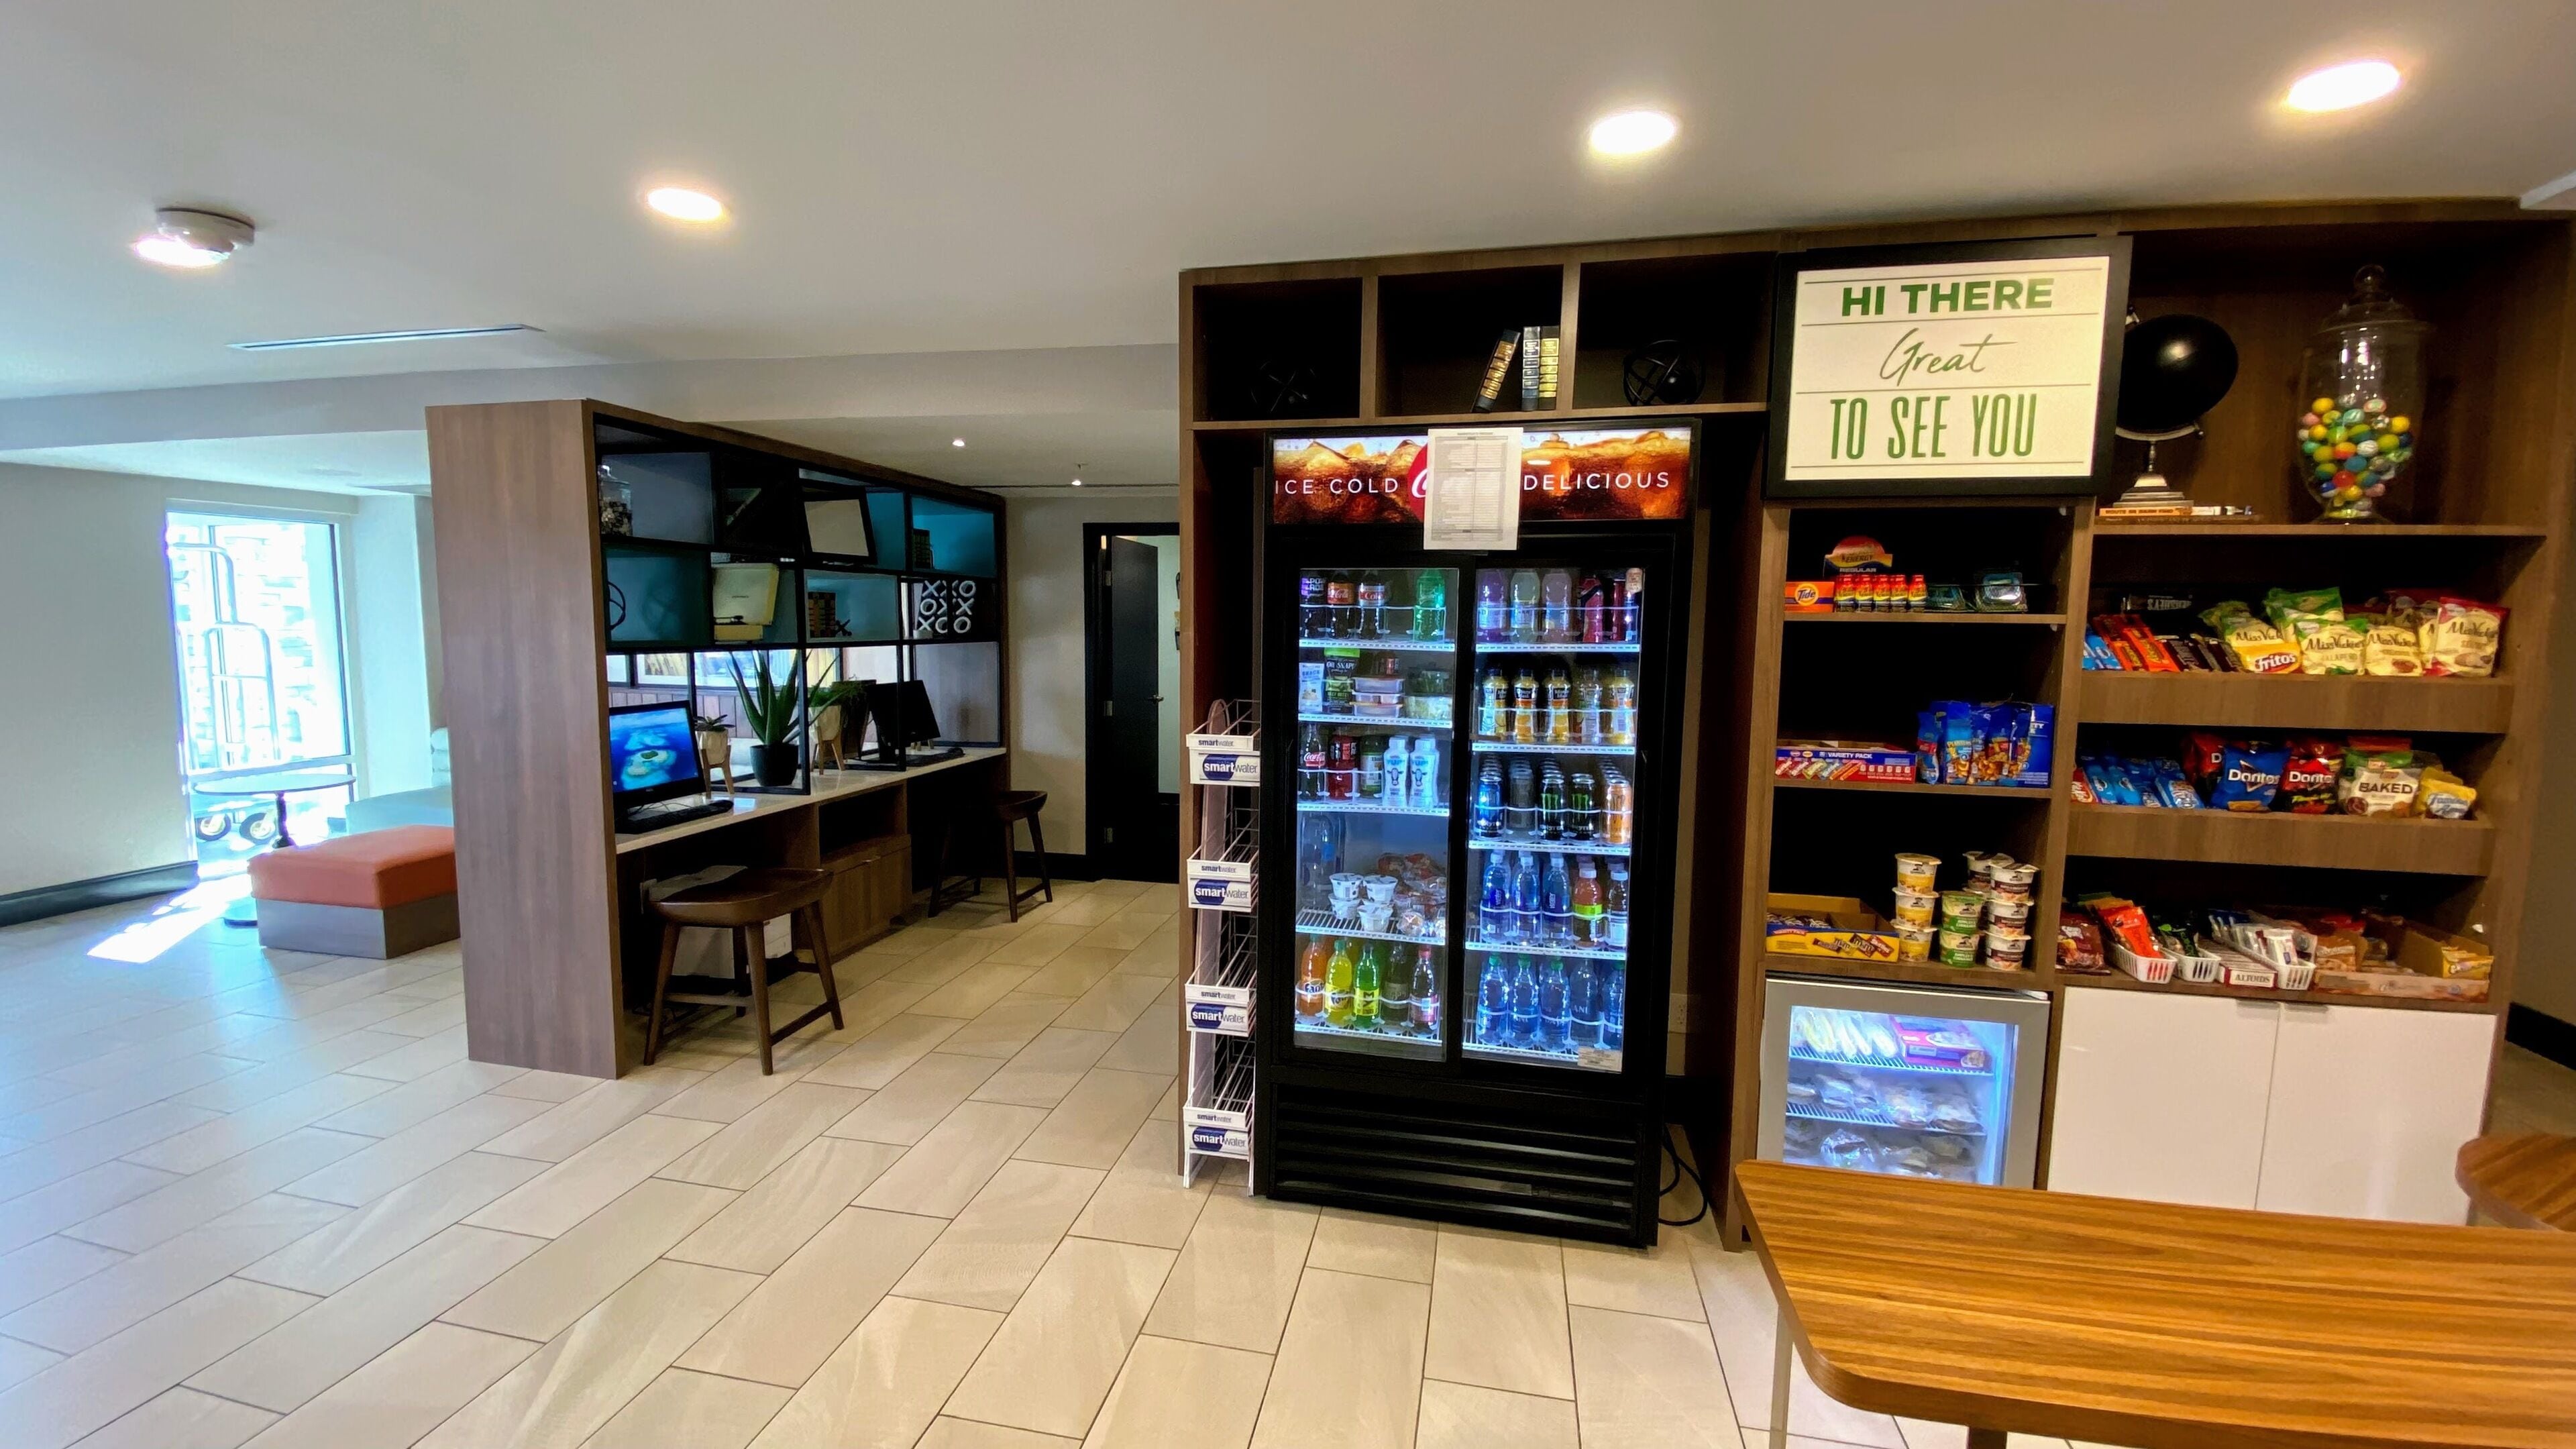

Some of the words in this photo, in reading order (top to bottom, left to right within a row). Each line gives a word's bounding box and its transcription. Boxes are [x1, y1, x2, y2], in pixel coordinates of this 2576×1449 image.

[1841, 286, 1885, 317] HI
[1900, 278, 2054, 313] THERE
[1879, 327, 2018, 386] Great
[1830, 397, 1868, 460] TO
[1887, 395, 1951, 459] SEE
[1972, 393, 2037, 458] YOU
[1275, 478, 1314, 495] ICE
[1329, 477, 1399, 494] COLD
[1523, 472, 1670, 491] DELICIOUS
[1797, 589, 1816, 602] Tide
[2255, 653, 2296, 672] Fritos
[1198, 739, 1234, 747] smartwater
[1204, 762, 1258, 773] smartwater
[2228, 768, 2280, 785] Doritos
[2359, 782, 2413, 794] BAKED
[1201, 865, 1236, 873] smartwater
[1195, 887, 1248, 899] smartwater
[1201, 991, 1236, 1000] smartwater
[1192, 1011, 1245, 1024] smartwater
[1197, 1114, 1232, 1123] smartwater
[1193, 1134, 1246, 1147] smartwater
